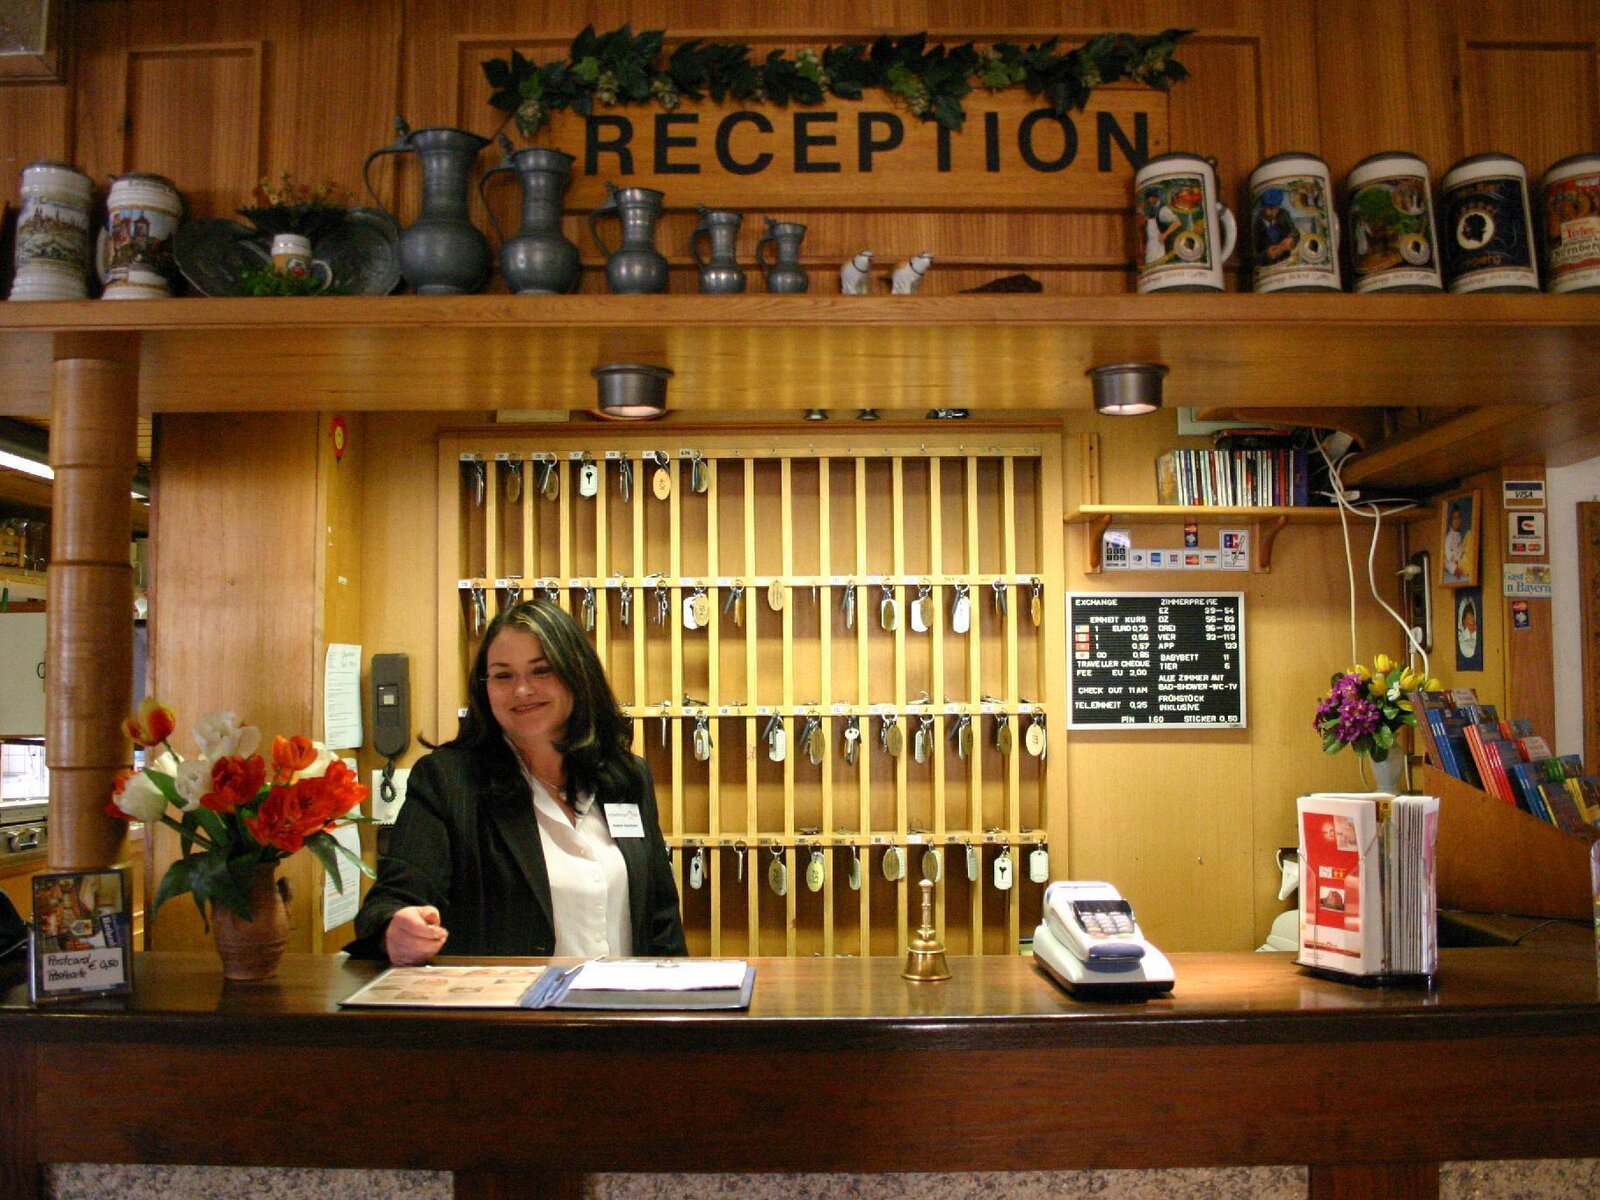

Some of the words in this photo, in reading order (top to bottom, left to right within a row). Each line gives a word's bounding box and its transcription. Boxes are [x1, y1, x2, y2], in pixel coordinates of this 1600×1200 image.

[584, 109, 1149, 176] RECEPTION
[1515, 490, 1533, 499] VISA
[1517, 582, 1551, 593] Bayern
[1224, 642, 1237, 650] 123
